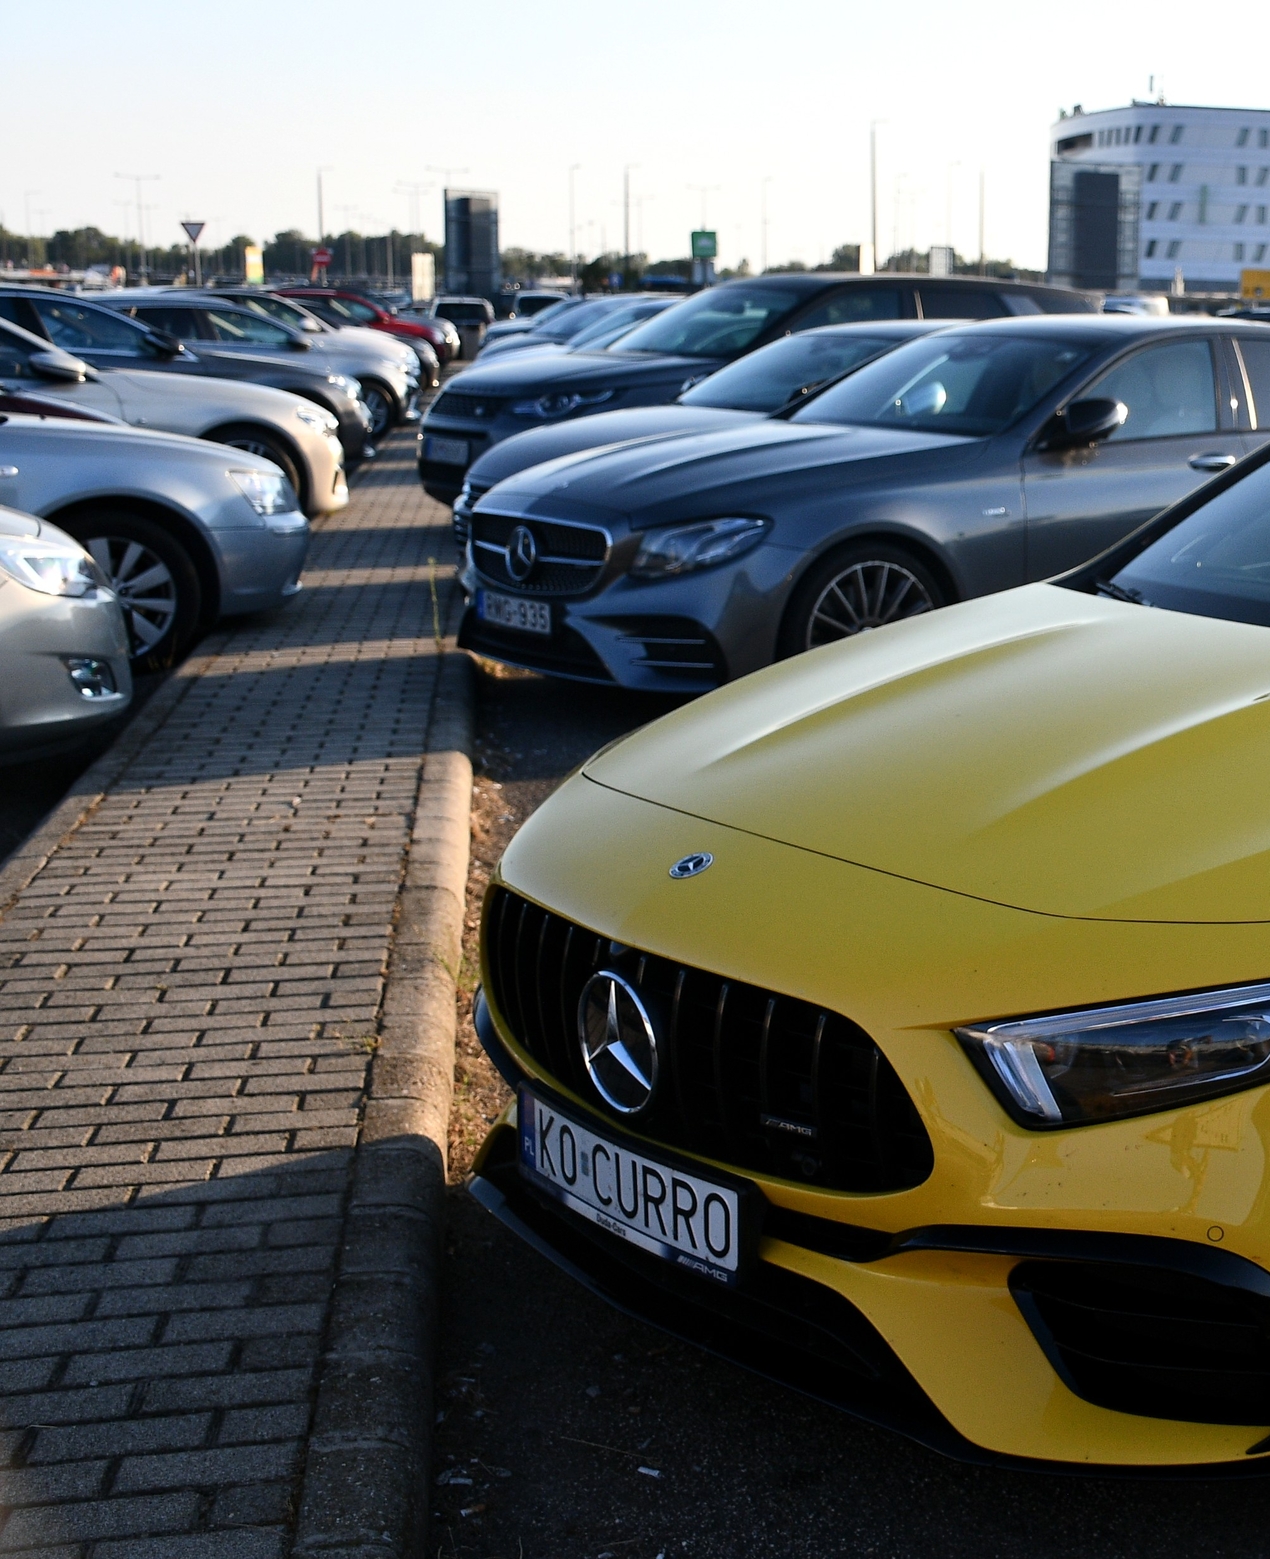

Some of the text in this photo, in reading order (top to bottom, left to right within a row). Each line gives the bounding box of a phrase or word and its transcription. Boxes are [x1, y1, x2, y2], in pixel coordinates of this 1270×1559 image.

[523, 1136, 535, 1157] PL
[591, 1143, 731, 1259] CURRO
[692, 1262, 728, 1283] AMG
